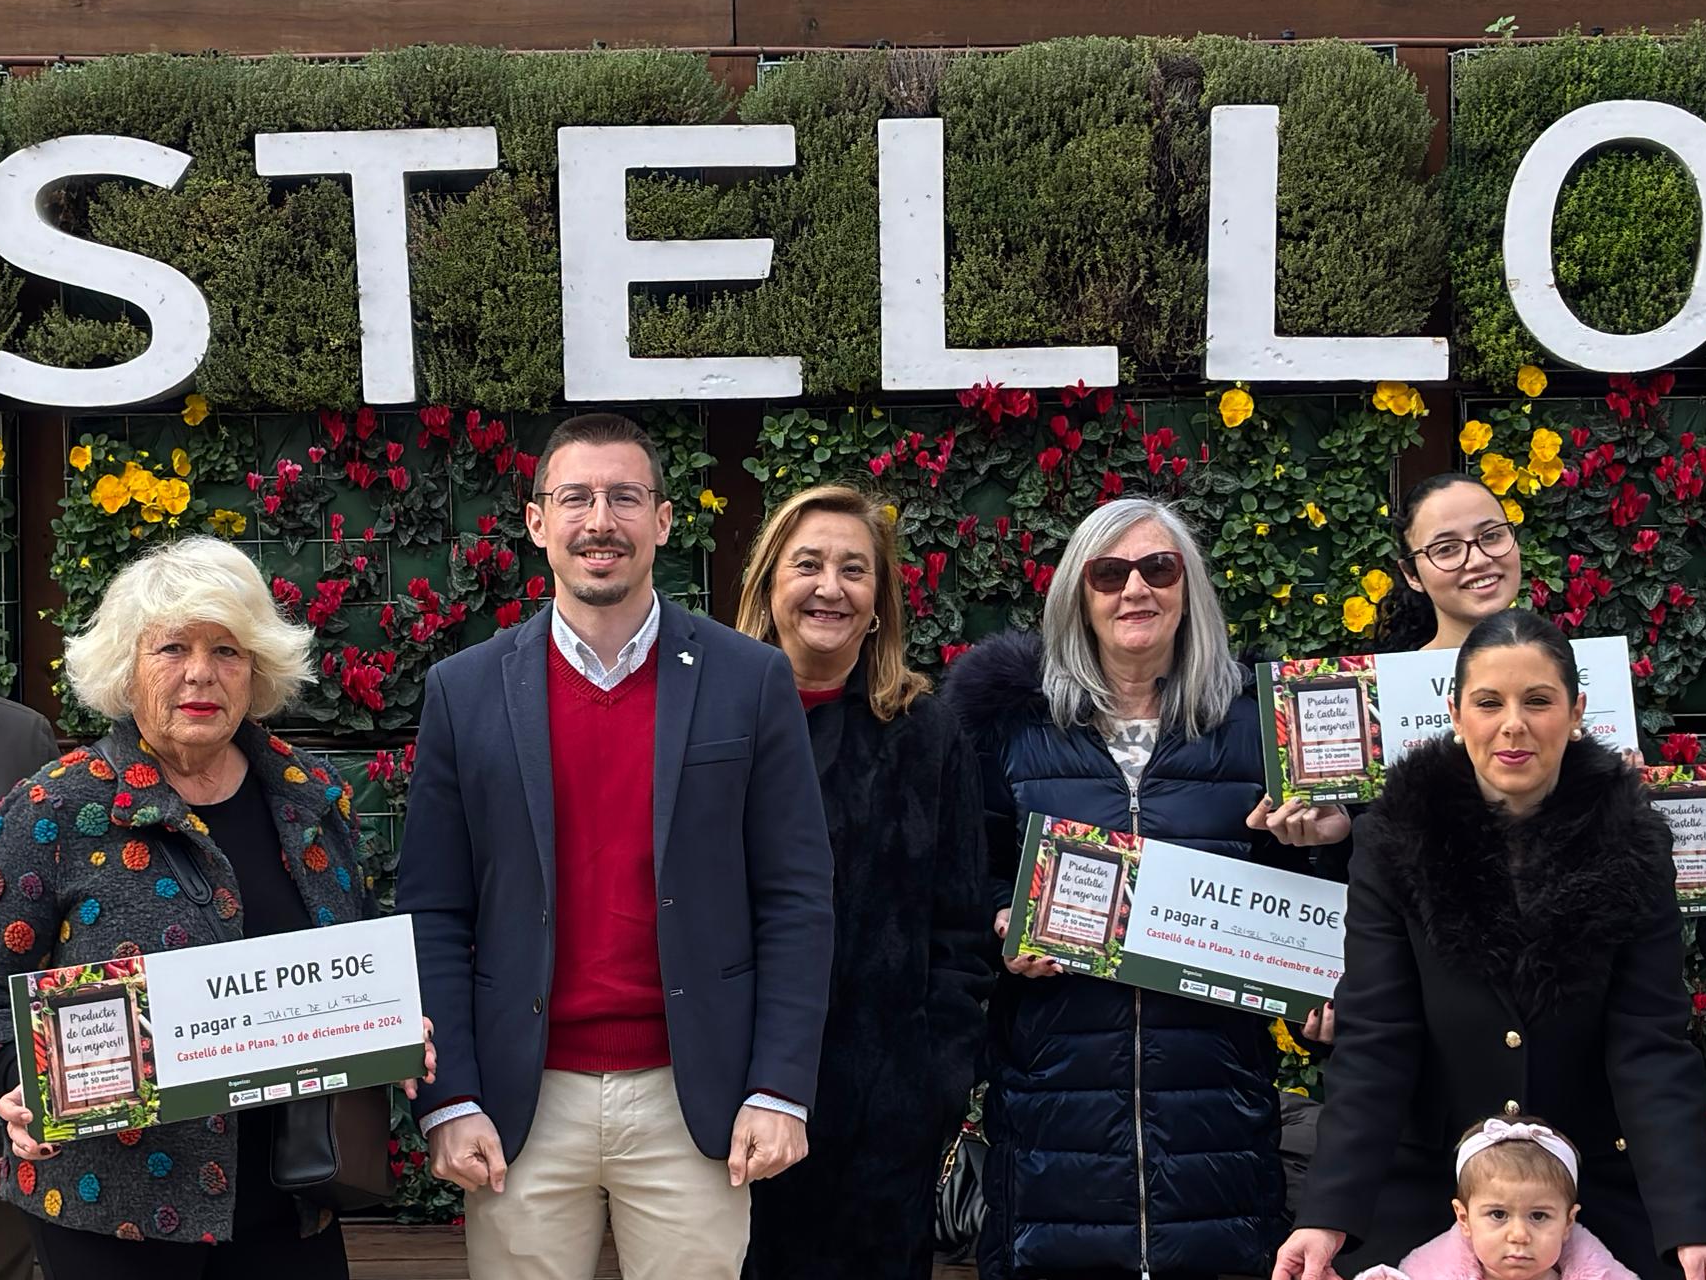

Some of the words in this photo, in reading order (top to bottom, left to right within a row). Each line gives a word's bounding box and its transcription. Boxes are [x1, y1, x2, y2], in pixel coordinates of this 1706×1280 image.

[1401, 716, 1409, 727] a
[1415, 714, 1452, 733] paga
[1592, 725, 1616, 736] 2024
[1190, 877, 1243, 907] VALE
[1249, 891, 1290, 918] POR
[1298, 903, 1339, 929] 50€
[1150, 905, 1158, 916] a
[1163, 908, 1206, 927] pagar
[1210, 919, 1218, 930] a
[206, 969, 267, 999] VALE
[275, 961, 322, 988] POR
[331, 953, 374, 979] 50€
[65, 1027, 78, 1039] de
[174, 1025, 183, 1038] a
[189, 1016, 236, 1039] pagar
[242, 1014, 251, 1026] a
[176, 1045, 217, 1062] Castelló
[219, 1044, 232, 1055] de
[235, 1042, 245, 1052] la
[247, 1038, 278, 1050] Plana,
[281, 1033, 294, 1044] 10
[296, 1031, 309, 1041] de
[311, 1023, 360, 1039] diciembre
[362, 1019, 374, 1030] de
[377, 1015, 402, 1028] 2024
[67, 1042, 81, 1054] los
